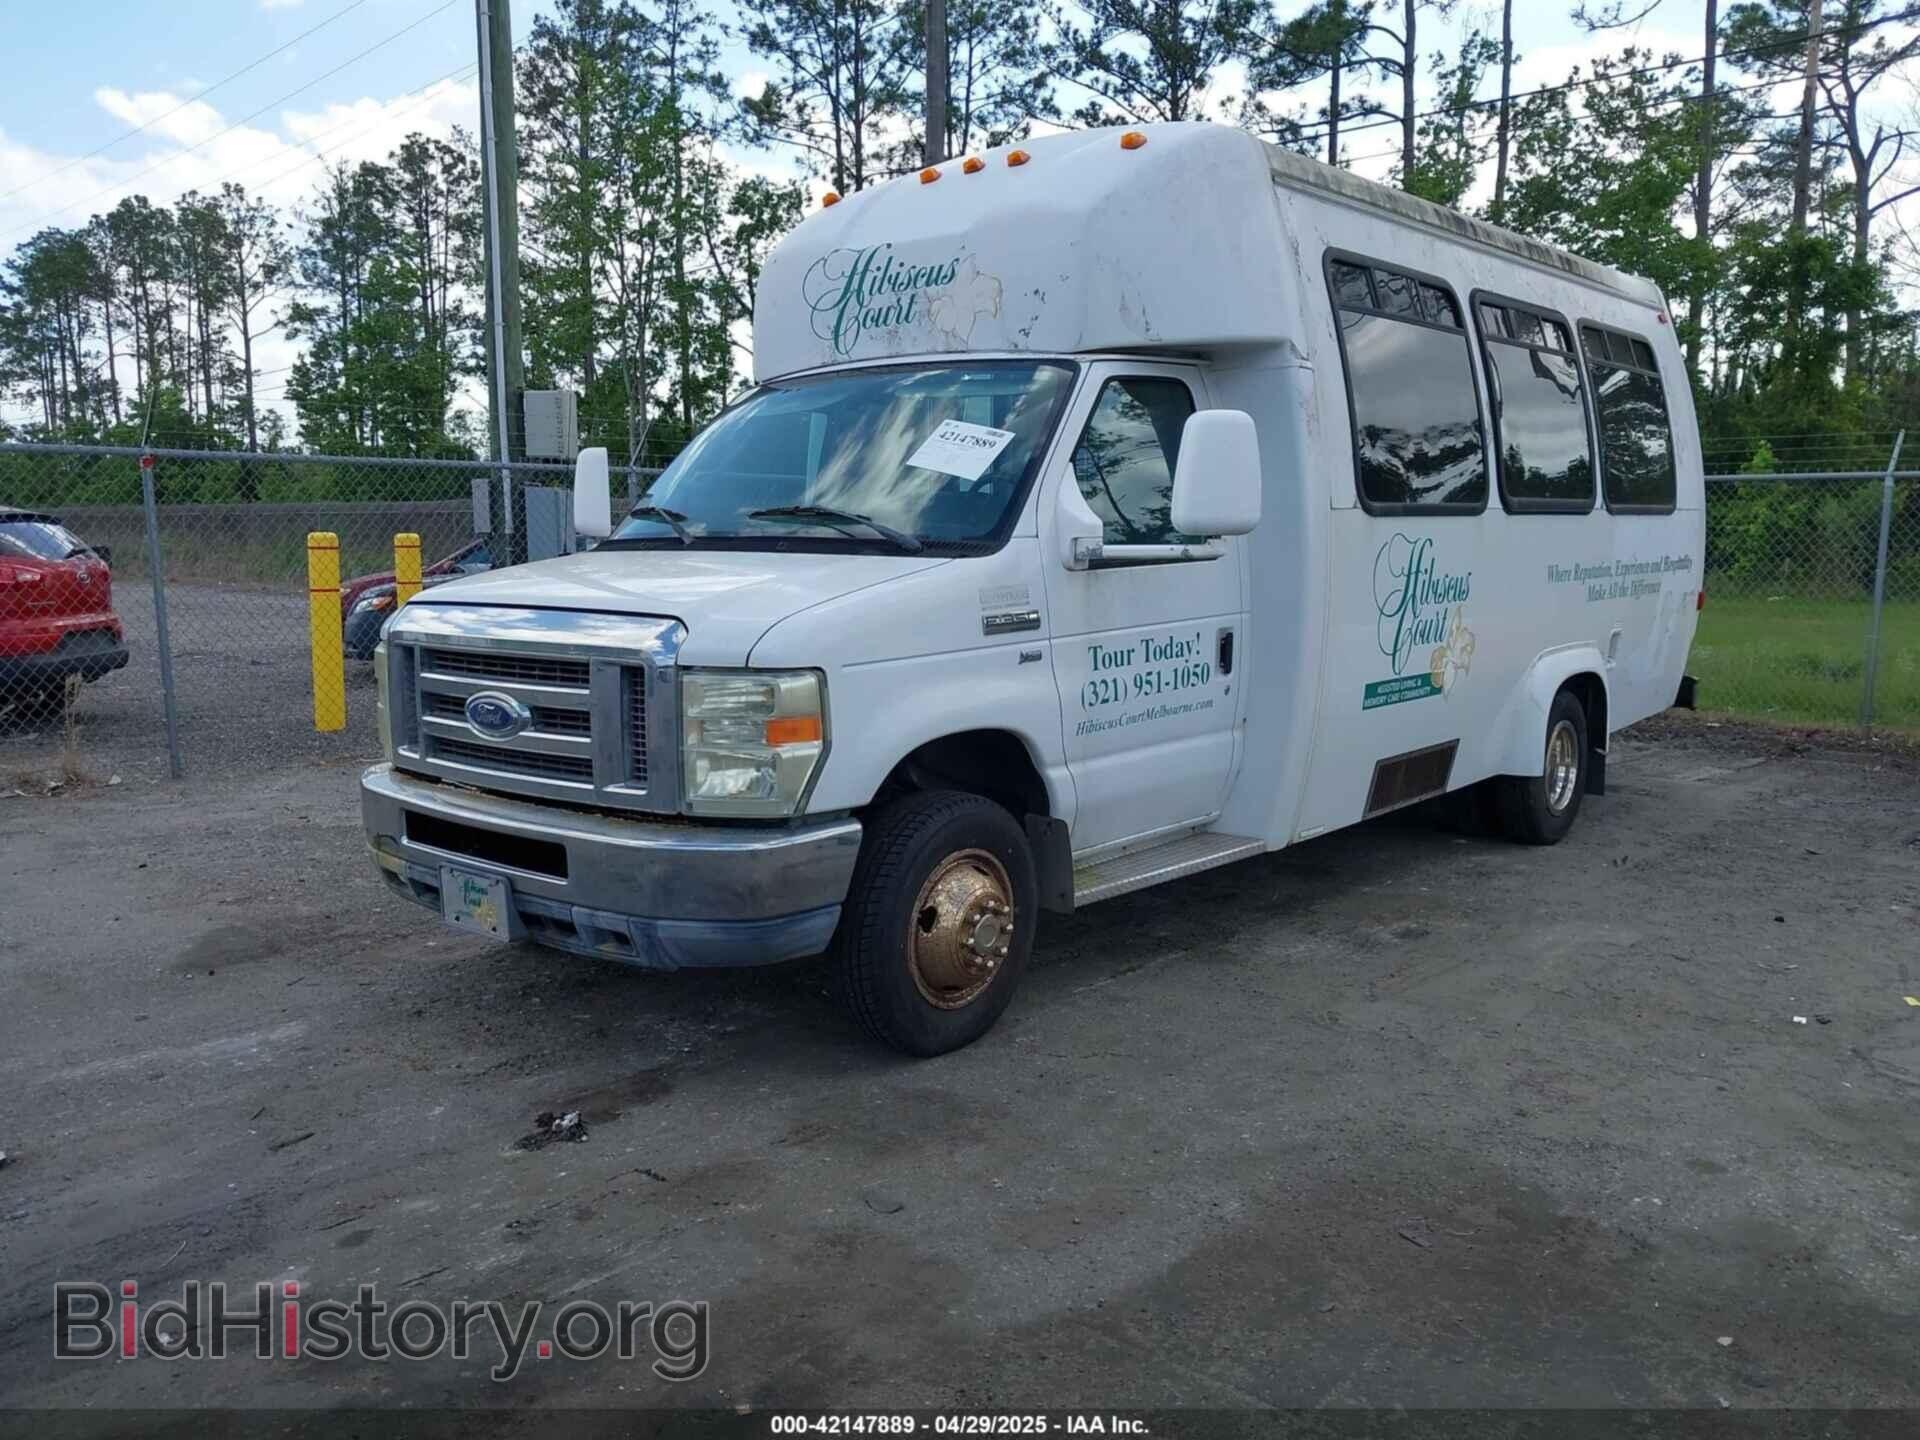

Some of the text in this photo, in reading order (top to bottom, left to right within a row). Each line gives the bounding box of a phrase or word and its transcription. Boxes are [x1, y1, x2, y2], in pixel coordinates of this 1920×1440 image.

[802, 243, 961, 311] Hibiscus
[810, 288, 916, 355] Court
[939, 430, 997, 449] 42147889
[1373, 533, 1472, 617] Hibiscus
[1547, 564, 1571, 584] Where
[1088, 632, 1201, 671] Tour Today!
[1378, 589, 1449, 675] Court
[1081, 662, 1211, 712] (321) 951-1050
[1075, 699, 1214, 737] HibiscusCourtMelbourne.com
